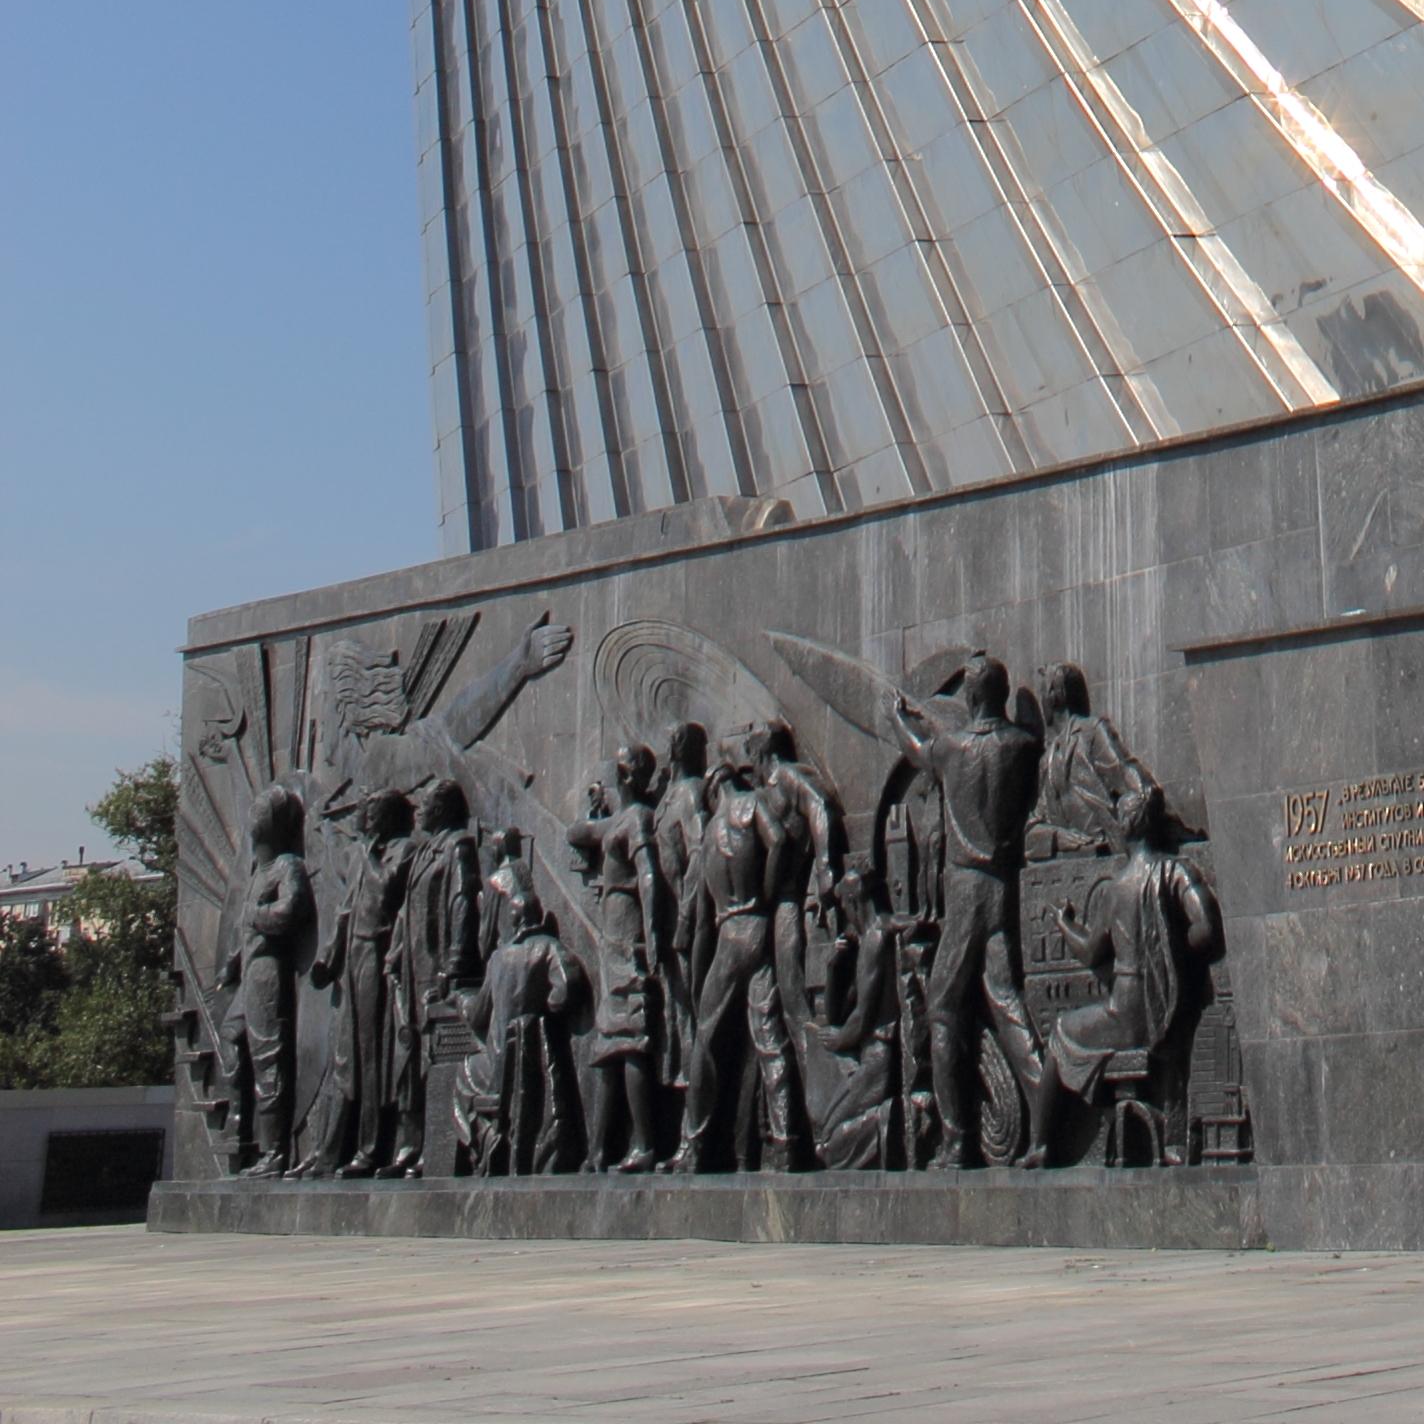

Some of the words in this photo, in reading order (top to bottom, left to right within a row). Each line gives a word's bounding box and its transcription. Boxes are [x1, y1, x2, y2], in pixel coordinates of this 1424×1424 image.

[1284, 789, 1330, 838] 1957
[1342, 807, 1413, 831] ИНСТИТУТОВ
[1295, 866, 1342, 889] ОКТЯБРЯ
[1344, 862, 1367, 882] 1957
[1368, 857, 1400, 880] ГОДА
[1403, 857, 1413, 875] В
